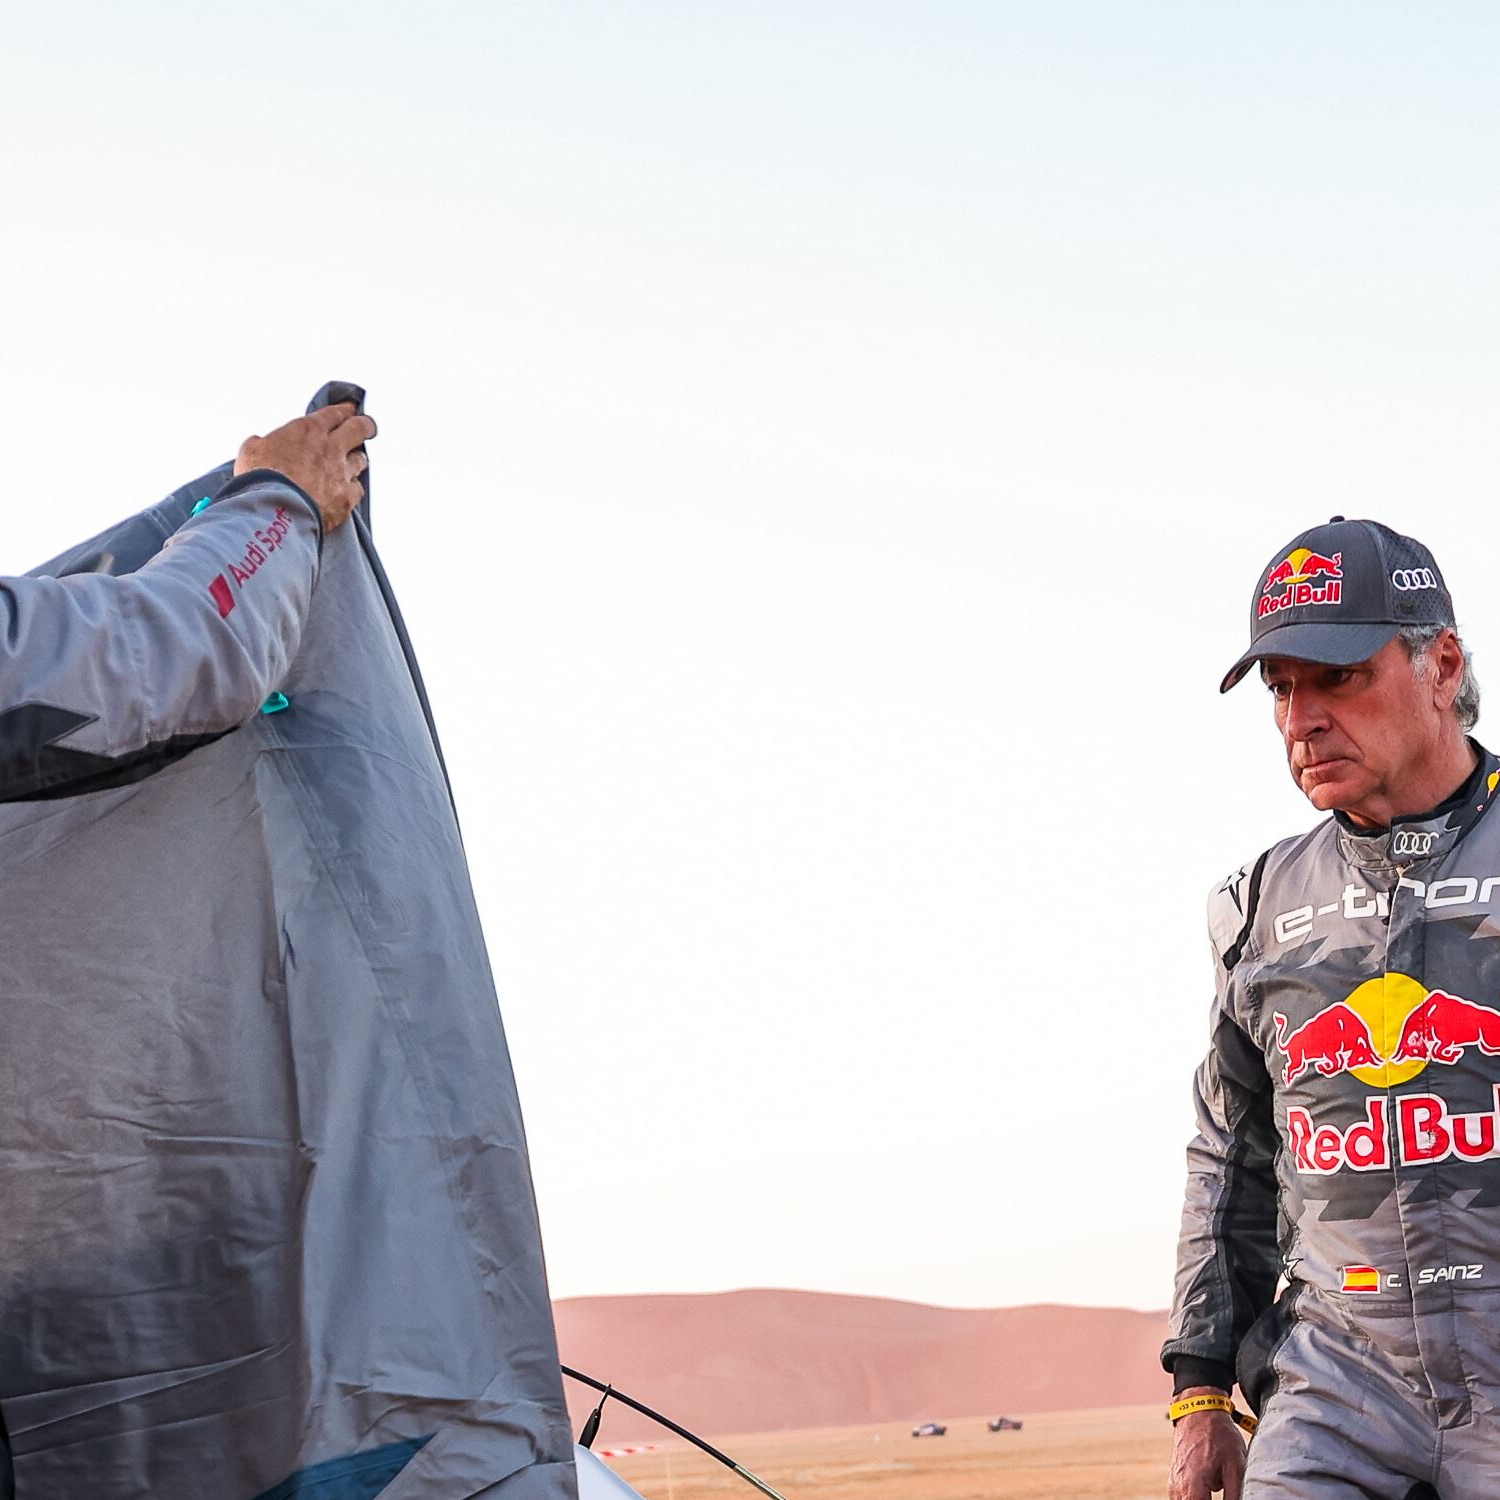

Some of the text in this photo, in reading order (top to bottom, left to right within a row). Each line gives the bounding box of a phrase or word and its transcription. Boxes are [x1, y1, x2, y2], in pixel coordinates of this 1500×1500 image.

[227, 506, 292, 589] Audi Sport
[1258, 580, 1342, 620] Red Bull
[1286, 1095, 1391, 1175] Red
[1386, 1264, 1484, 1288] C. SAINZ
